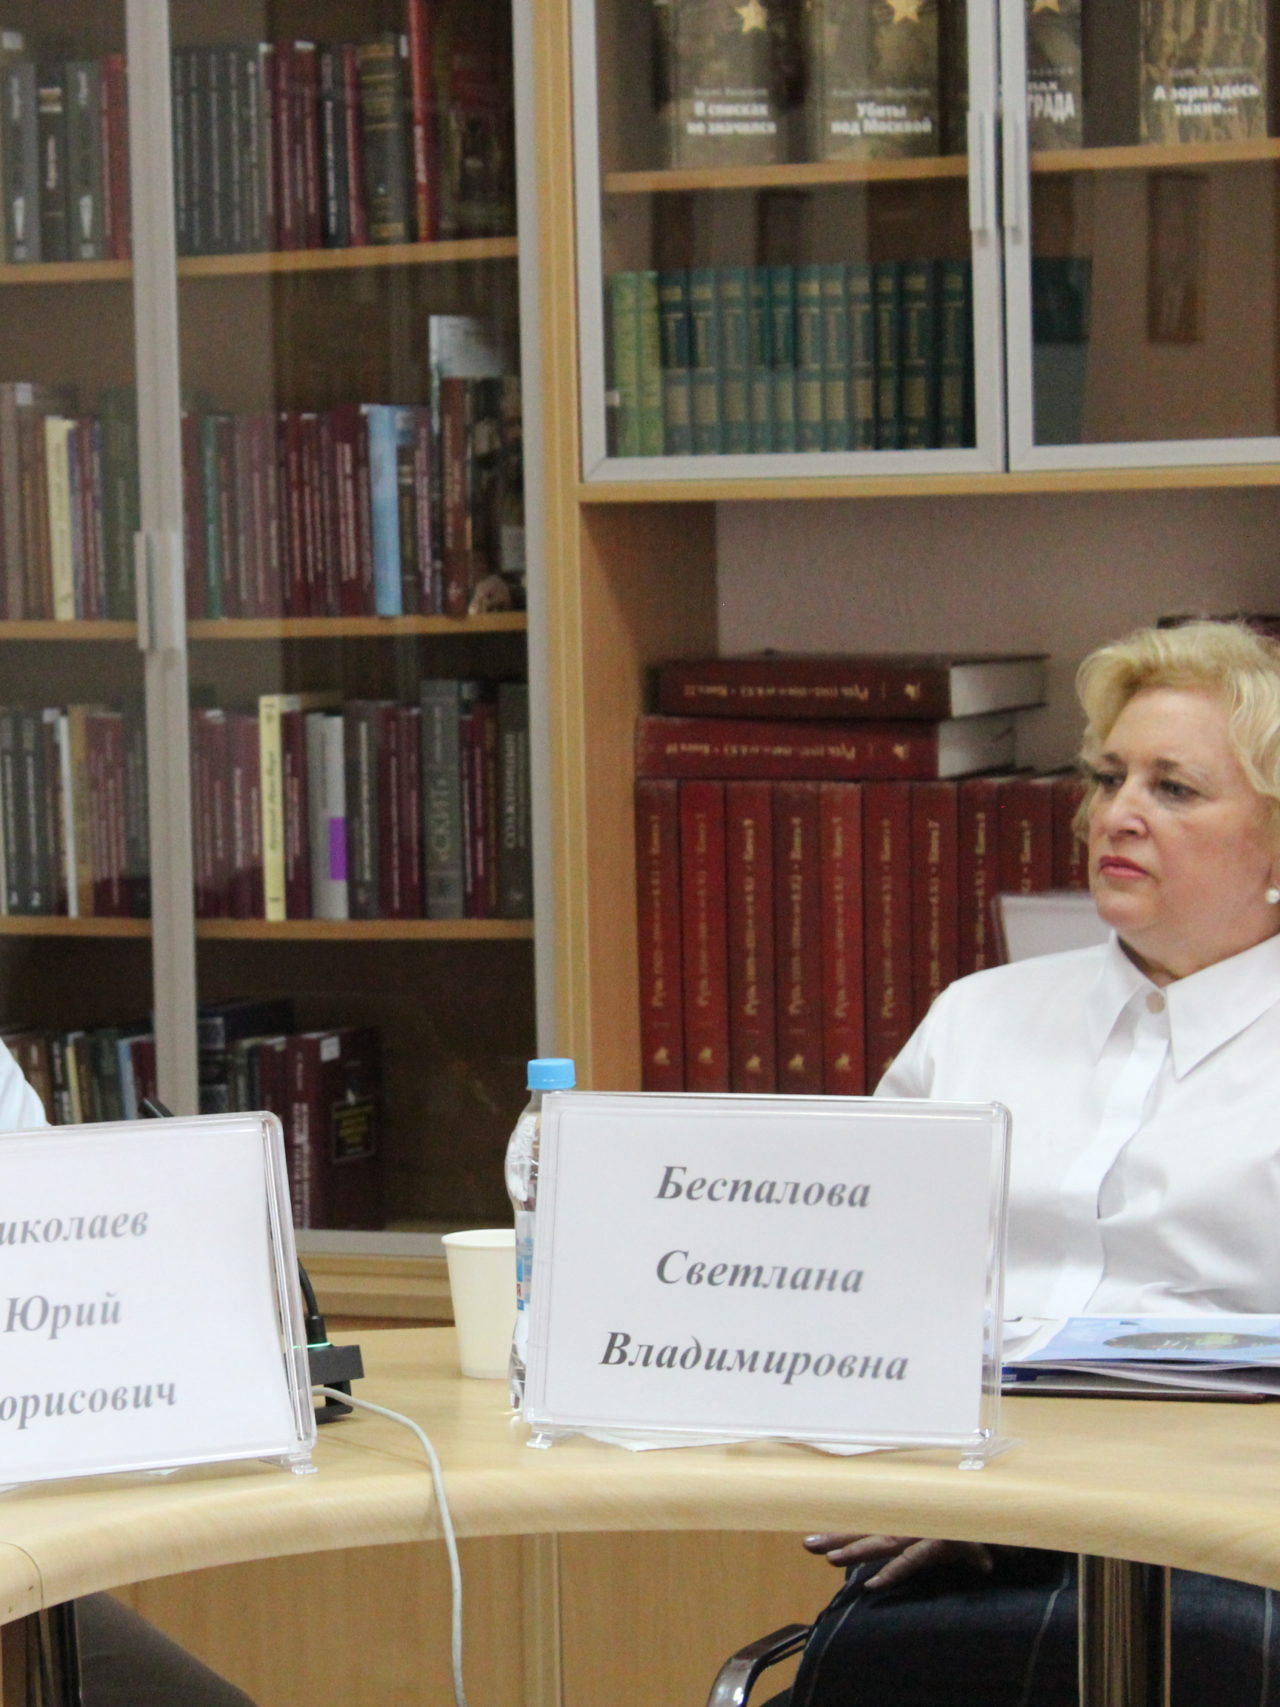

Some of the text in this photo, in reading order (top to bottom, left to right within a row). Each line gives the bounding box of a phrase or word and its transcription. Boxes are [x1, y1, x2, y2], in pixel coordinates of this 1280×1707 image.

[1153, 84, 1167, 100] А
[1212, 83, 1260, 99] здесь
[655, 1165, 872, 1208] Беспалова
[655, 1249, 865, 1293] Светлана
[3, 1291, 122, 1340] Юрий
[598, 1331, 910, 1386] Владимировна
